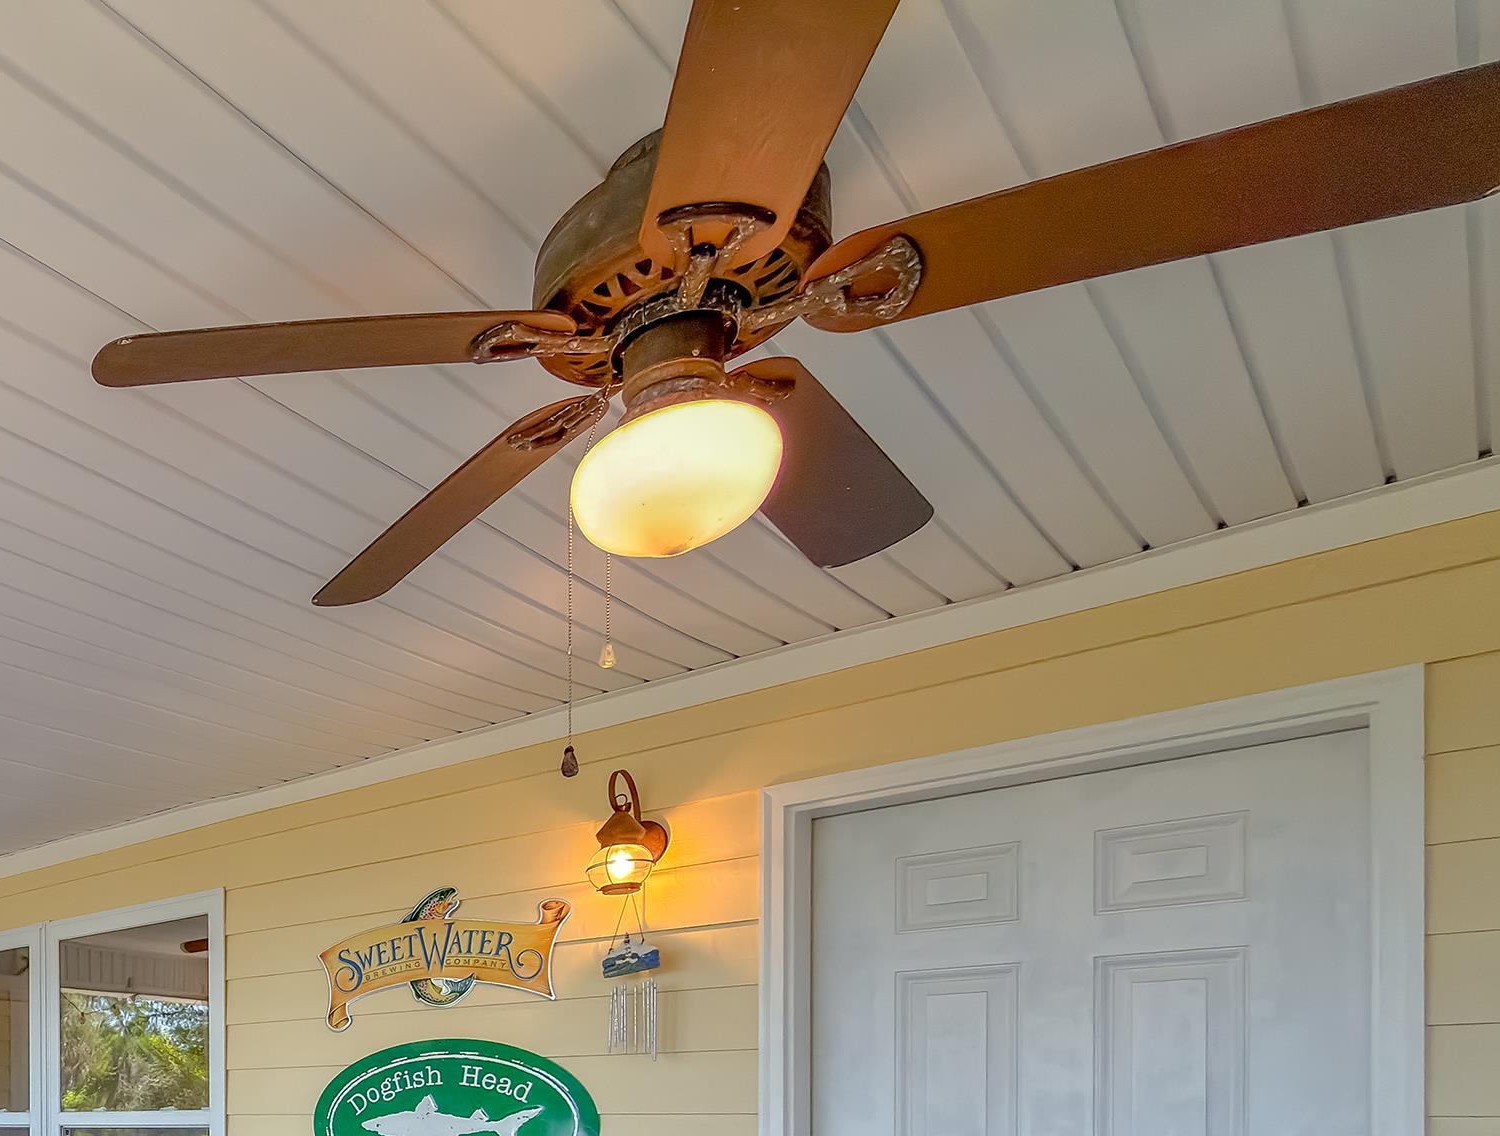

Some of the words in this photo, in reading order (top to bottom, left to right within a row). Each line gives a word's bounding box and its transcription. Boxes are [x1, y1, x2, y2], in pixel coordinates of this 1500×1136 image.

[365, 961, 422, 982] BREWING
[445, 958, 508, 969] COMPANY
[346, 1065, 444, 1116] Dogfish
[459, 1065, 534, 1104] Head
